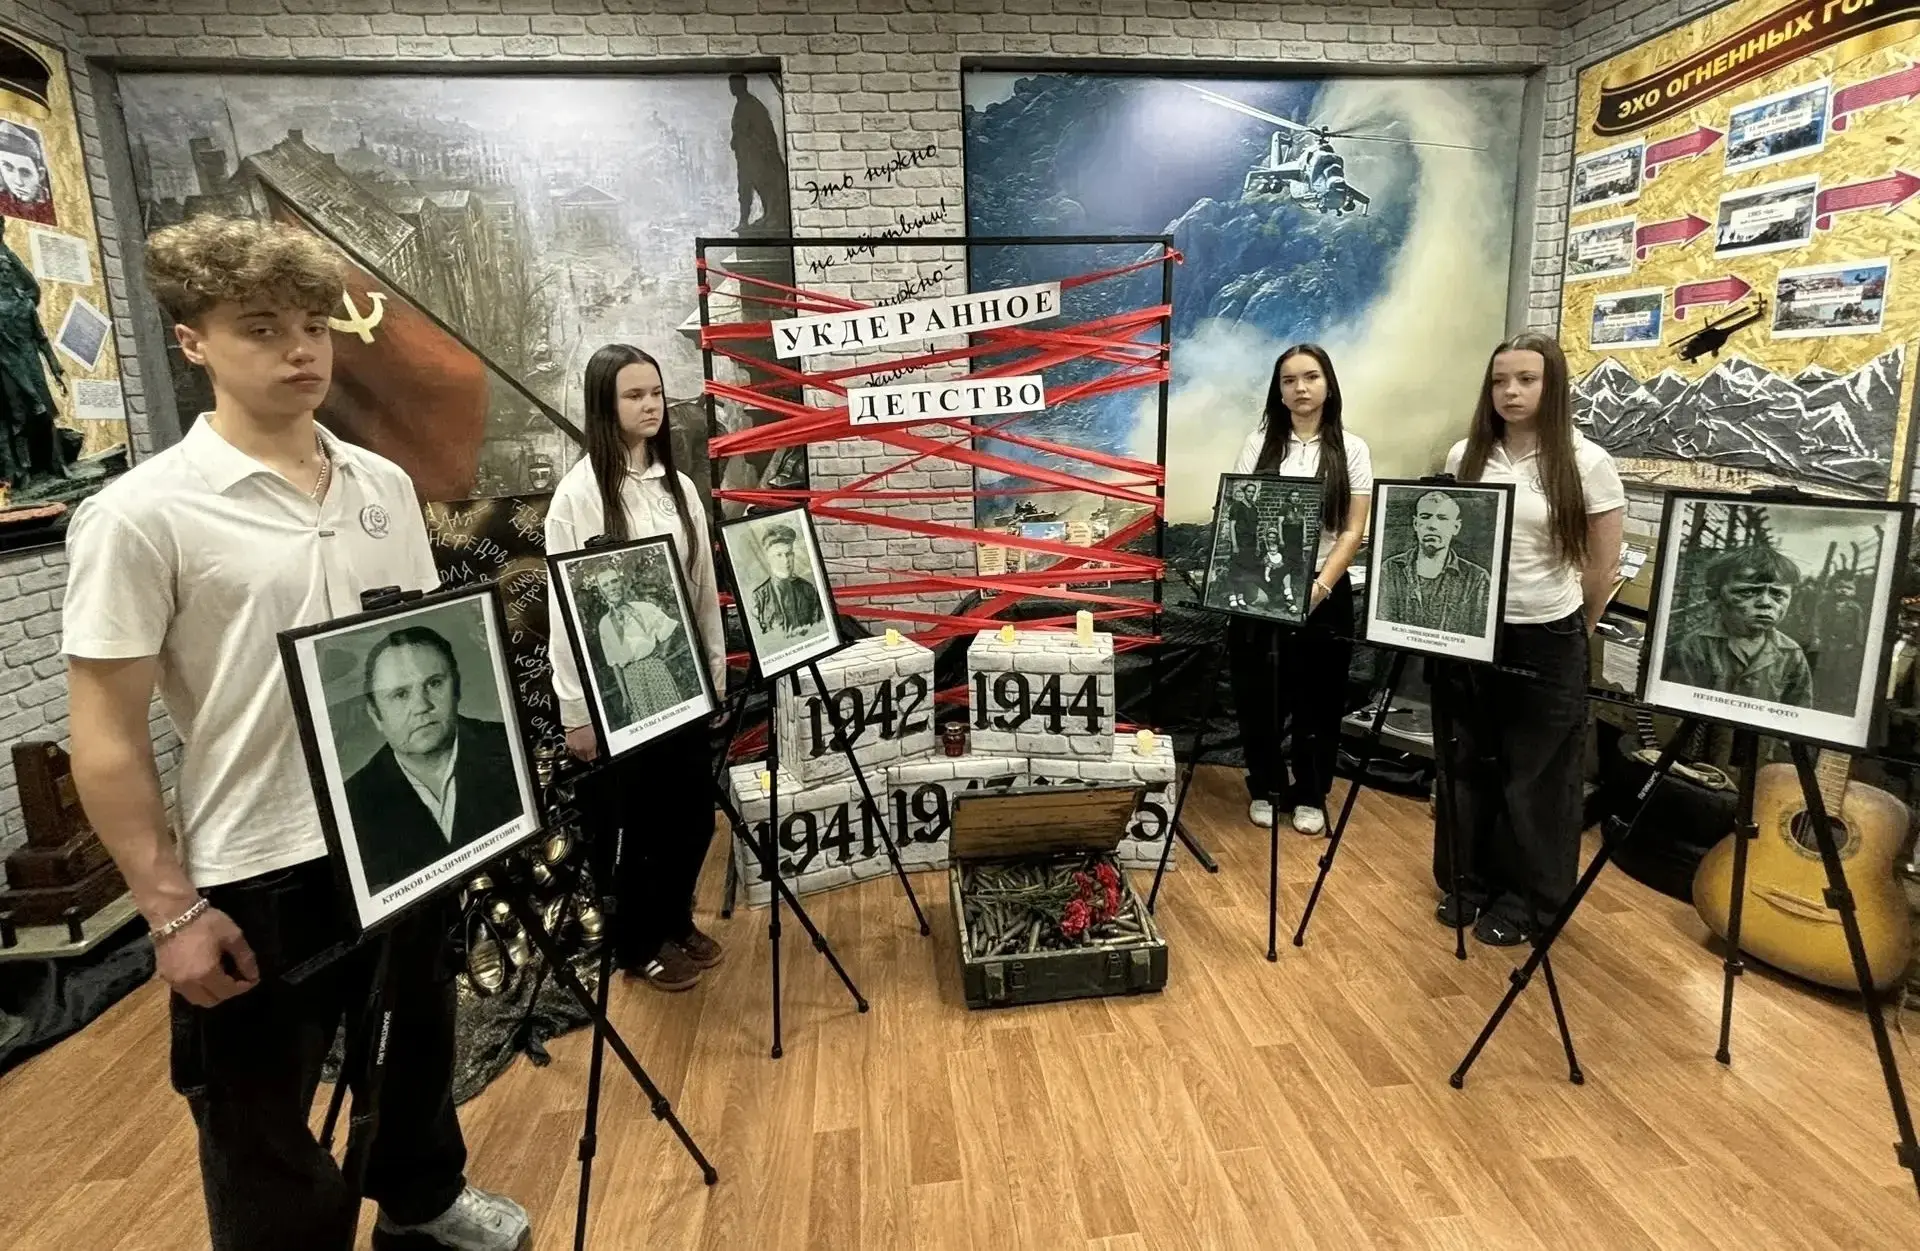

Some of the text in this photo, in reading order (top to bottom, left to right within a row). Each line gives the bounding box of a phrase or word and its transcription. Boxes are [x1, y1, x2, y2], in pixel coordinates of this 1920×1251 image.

[1618, 0, 1873, 118] ЭХО ОГНЕННЫХ ГО
[805, 144, 937, 205] Это нужно
[809, 255, 836, 274] не
[780, 290, 1053, 351] УКДЕРАННОЕ
[856, 383, 1041, 423] ДЕТСТВО
[805, 673, 930, 758] 1942
[972, 671, 1105, 735] 1944
[1693, 692, 1799, 718] НЕИЗВЕСТНОЕ ФОТО
[382, 823, 521, 905] КРЮКОВ ВЛАДИМИР НИКИТОВИЧ
[753, 800, 881, 881] 1941
